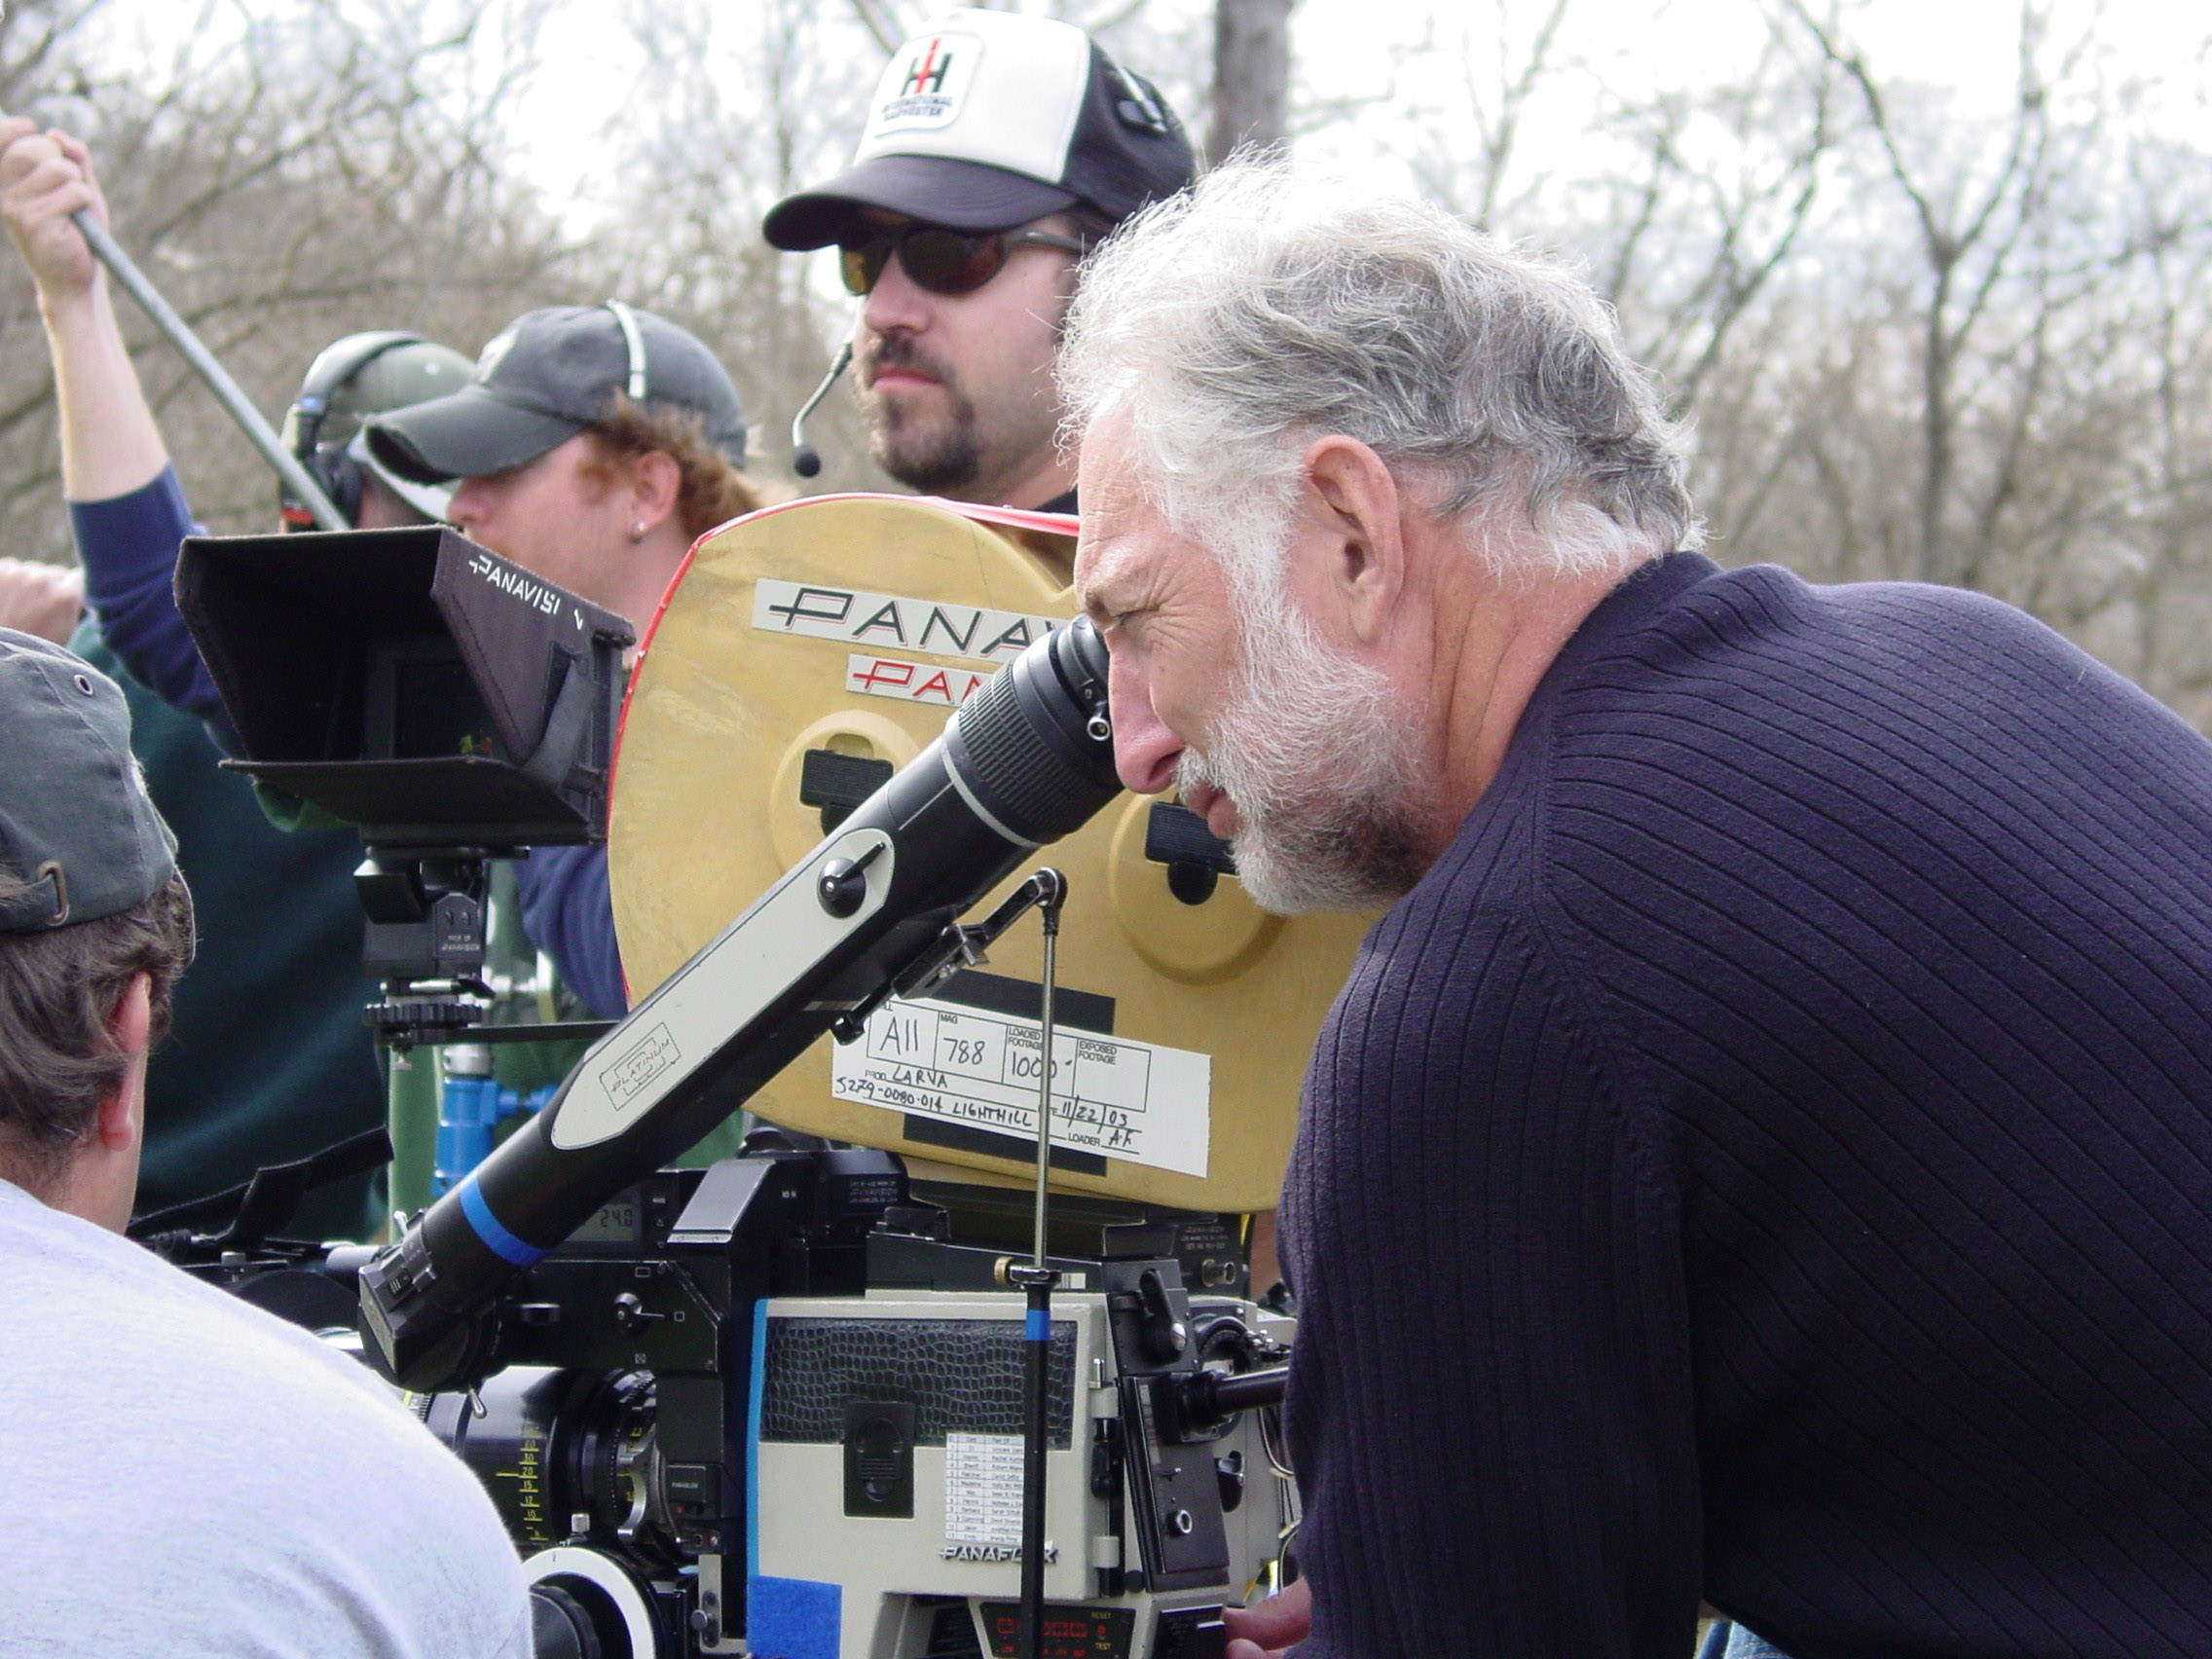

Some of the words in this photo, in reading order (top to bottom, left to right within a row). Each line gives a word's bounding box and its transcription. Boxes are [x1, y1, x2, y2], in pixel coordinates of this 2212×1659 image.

[768, 587, 1055, 655] PANA
[940, 1014, 958, 1024] MAG
[1009, 1027, 1040, 1040] LOADED
[943, 1037, 985, 1065] 788
[1079, 1042, 1117, 1054] EXPOSED
[1079, 1051, 1116, 1064] FOOTAGE
[611, 1039, 670, 1092] PLATINUM
[893, 1065, 948, 1088] LARVA
[952, 1102, 1032, 1126] LIGHTHILL
[1068, 1132, 1101, 1146] LOADER
[526, 1495, 533, 1504] 12
